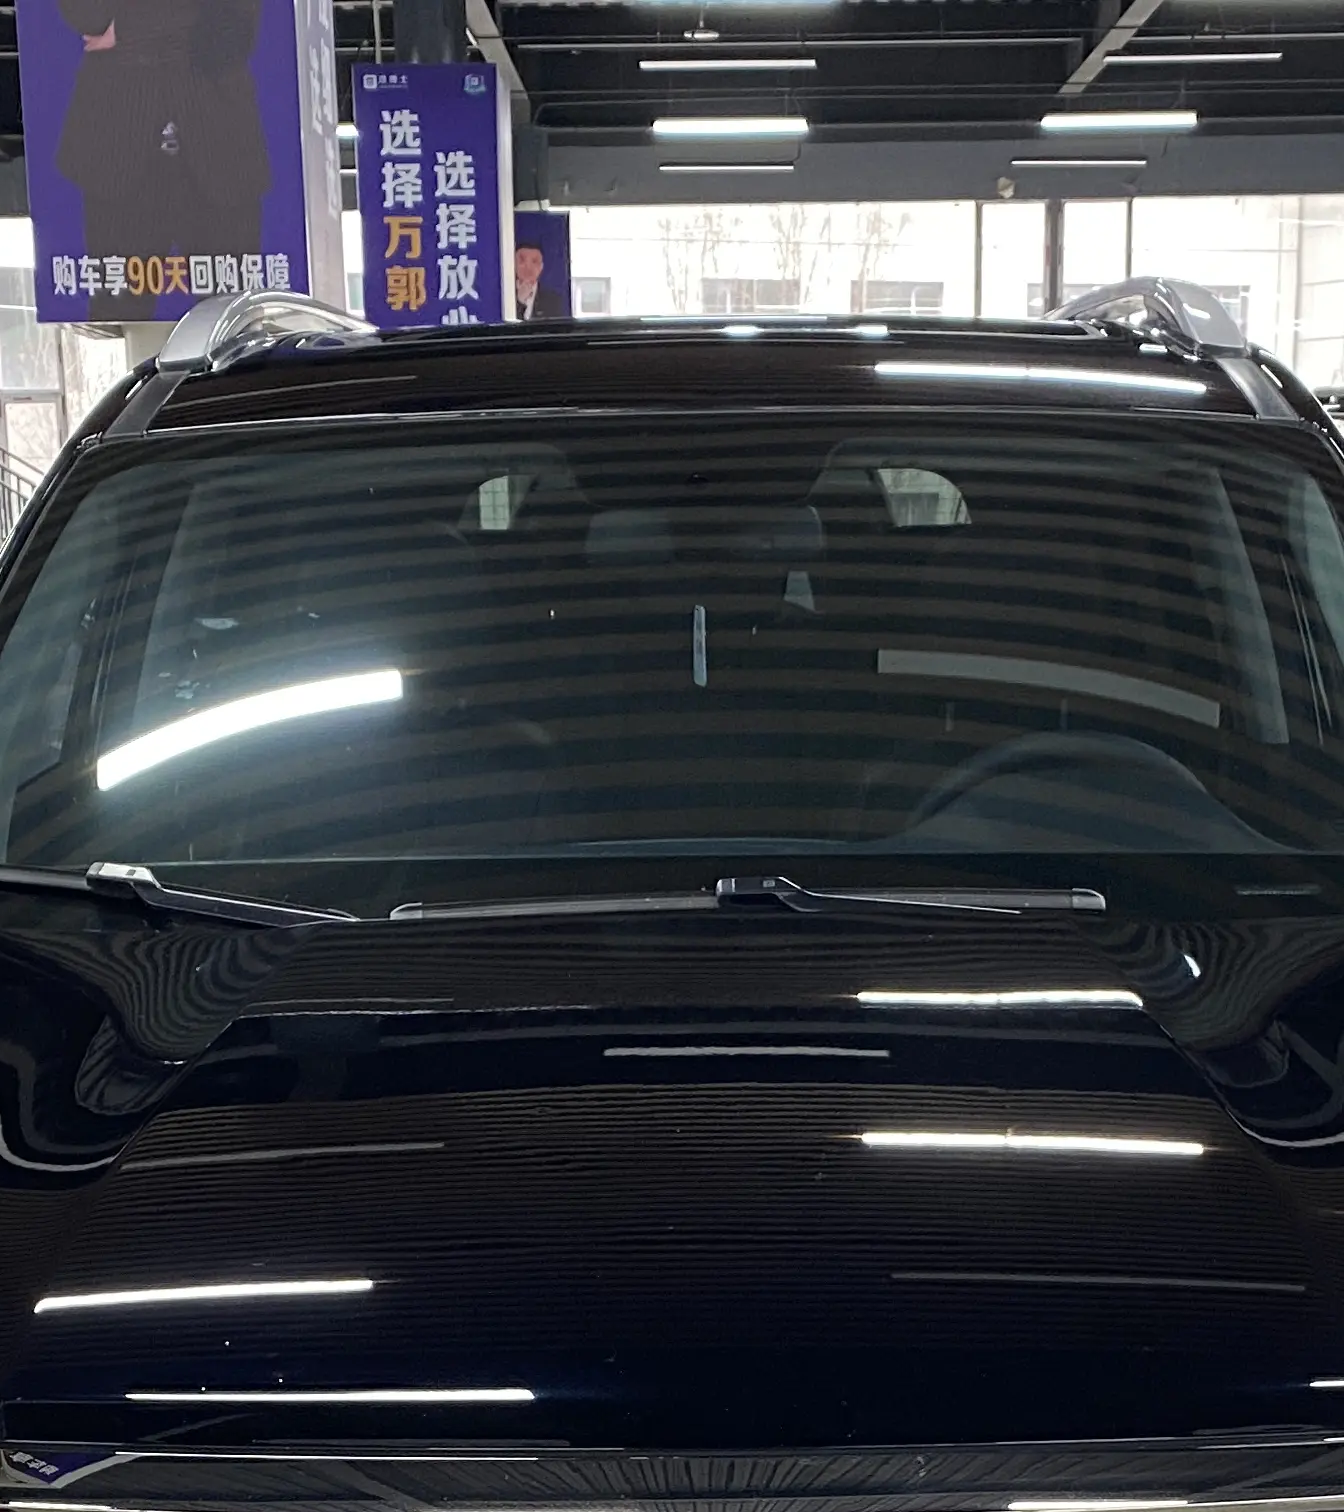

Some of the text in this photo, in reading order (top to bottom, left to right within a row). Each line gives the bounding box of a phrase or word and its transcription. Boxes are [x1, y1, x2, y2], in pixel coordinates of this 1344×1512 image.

[379, 109, 427, 312] 选择万郭
[52, 253, 291, 296] 购车享90天回购保障
